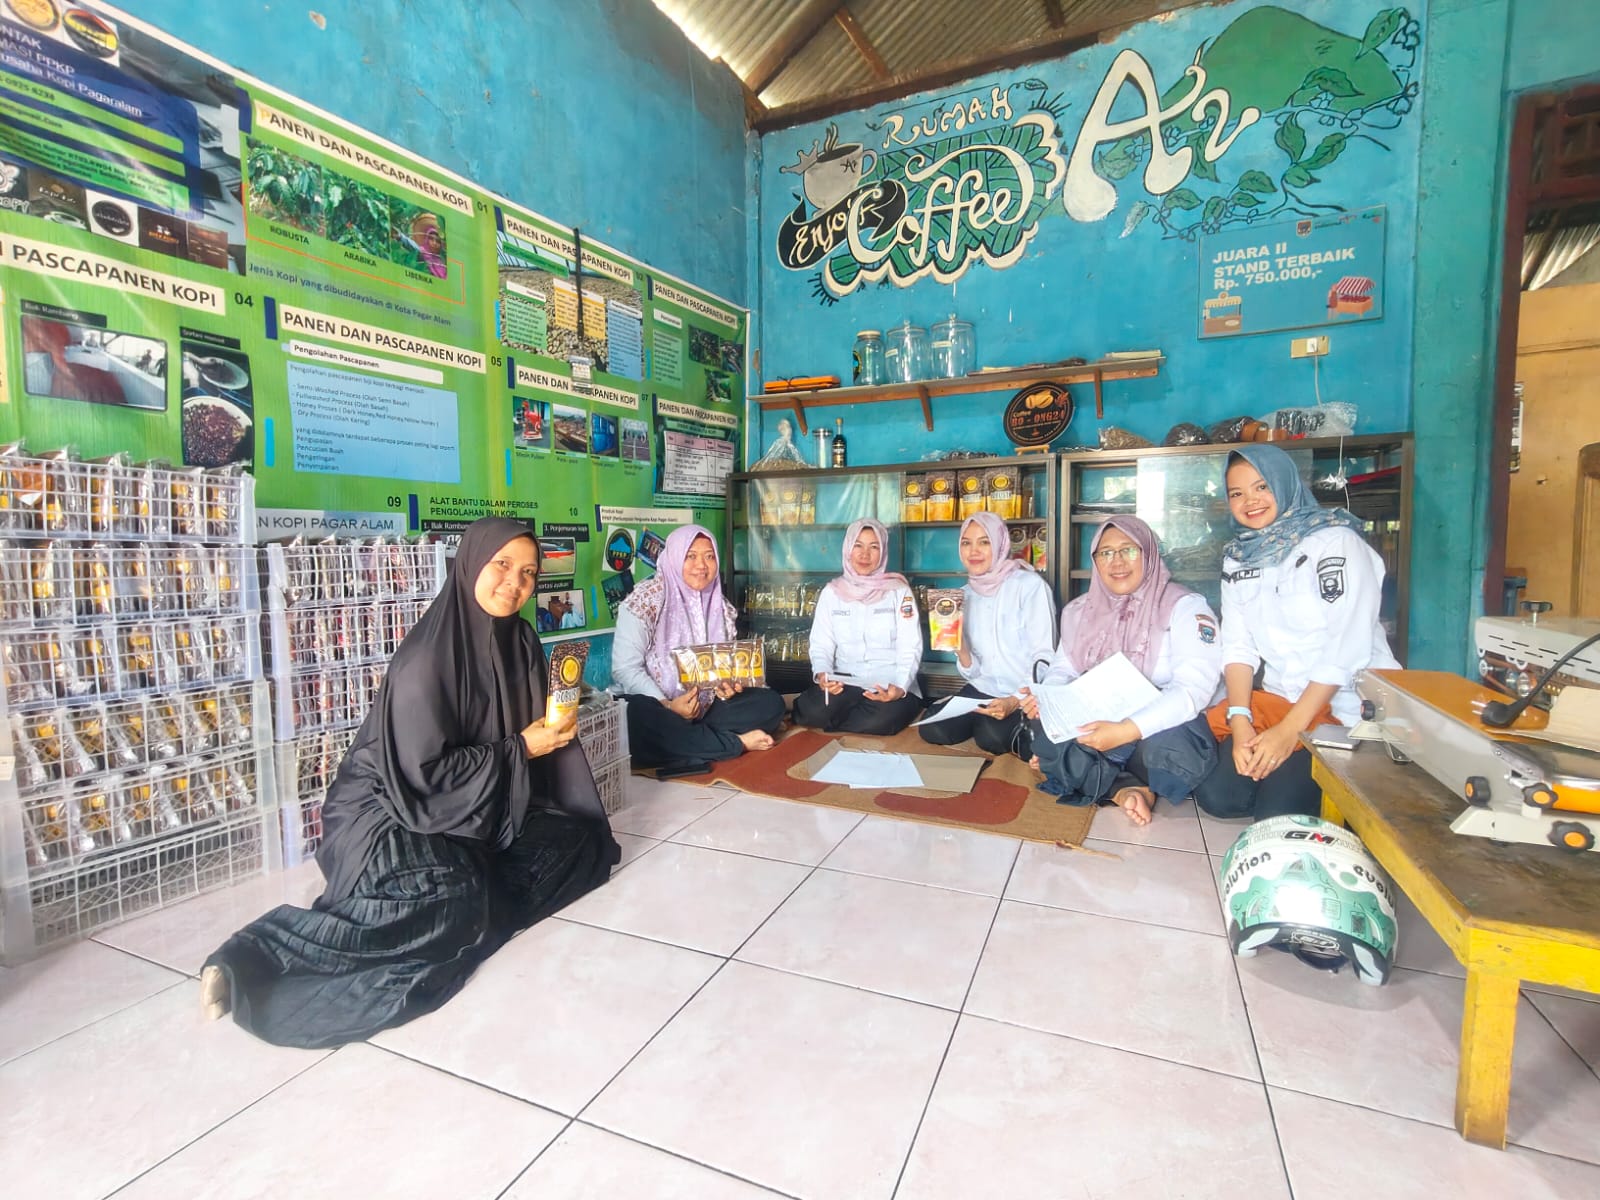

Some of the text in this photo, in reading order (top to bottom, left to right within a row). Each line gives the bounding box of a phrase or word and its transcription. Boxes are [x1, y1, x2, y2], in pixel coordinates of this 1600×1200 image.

[0, 24, 42, 50] NTAK
[79, 82, 143, 117] Pagaralam
[260, 107, 489, 214] PANEN DAN PASCAPANEN KOPI 01
[848, 144, 1035, 268] Coffee
[269, 225, 310, 246] ROBUSTA
[343, 250, 378, 268] ARABIKA
[506, 219, 539, 240] PANEN
[540, 234, 560, 250] DAN
[561, 243, 612, 271] PASAPANEN
[613, 265, 631, 281] KOPI
[1212, 245, 1271, 264] JUARA
[12, 243, 166, 295] PASCAPANEN
[171, 284, 217, 308] KOPI
[234, 292, 255, 308] 04
[1214, 247, 1356, 279] STAND TERBAIK
[249, 262, 274, 277] Jenis
[275, 270, 299, 285] Kopi
[300, 277, 323, 292] yang
[1213, 266, 1323, 291] Rp. 750.000,-
[654, 283, 677, 301] PANEN
[283, 311, 503, 369] PANEN DAN PASCAPANEN KOPI 05
[294, 344, 380, 369] Pengolahan Pascapanen
[518, 370, 549, 386] PANEN
[550, 378, 569, 391] DAN
[619, 394, 637, 406] KOPI
[659, 402, 681, 415] PANEN
[387, 496, 402, 508] 09
[430, 496, 539, 509] ALAT BANTU DALAM PEROSES
[430, 507, 485, 518] PENGOLAHAN
[273, 516, 307, 530] KOPI
[311, 517, 361, 530] PAGAR
[360, 518, 395, 531] ALAM
[444, 523, 471, 532] Ramban
[1283, 830, 1336, 845] GM
